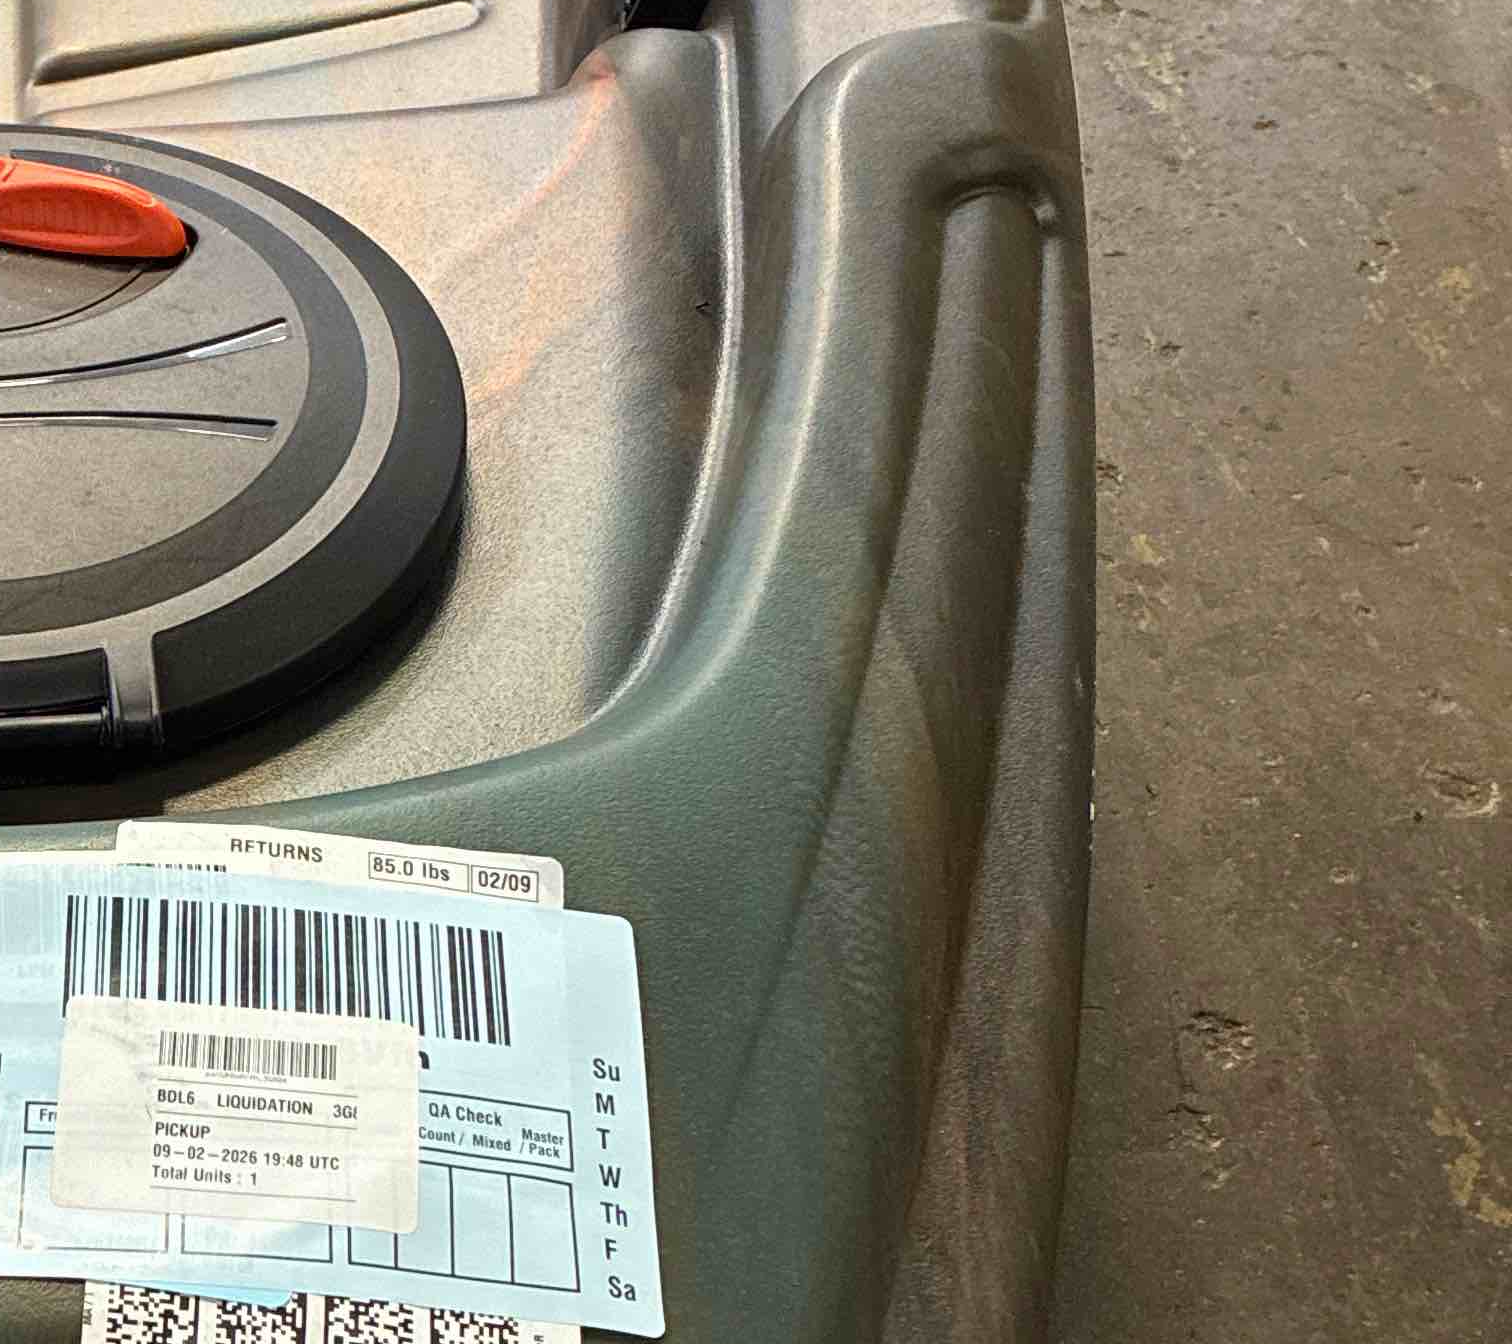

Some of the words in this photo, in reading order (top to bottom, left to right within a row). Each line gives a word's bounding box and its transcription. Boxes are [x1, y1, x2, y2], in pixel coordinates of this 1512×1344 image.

[230, 838, 323, 863] RETURNS
[373, 856, 414, 876] 85.0
[422, 861, 451, 882] lbs
[477, 870, 532, 894] 02/09
[592, 1058, 621, 1082] Su
[157, 1088, 195, 1105] BDL6
[217, 1093, 313, 1115] LIQUIDATION
[595, 1092, 616, 1116] M
[40, 1108, 58, 1123] Fr
[428, 1102, 451, 1120] QA
[455, 1105, 503, 1127] Check
[154, 1121, 211, 1139] PICKUP
[521, 1128, 565, 1146] Master
[595, 1128, 611, 1150] T
[472, 1134, 511, 1152] Mixed
[528, 1143, 561, 1159] Pack
[263, 1152, 304, 1168] 19:48
[309, 1155, 341, 1170] UTC
[152, 1164, 188, 1181] Total
[193, 1167, 232, 1184] Units
[250, 1172, 258, 1186] 1
[598, 1163, 621, 1189] W
[599, 1202, 628, 1227] Th
[604, 1238, 617, 1260] F
[607, 1275, 637, 1301] Sa
